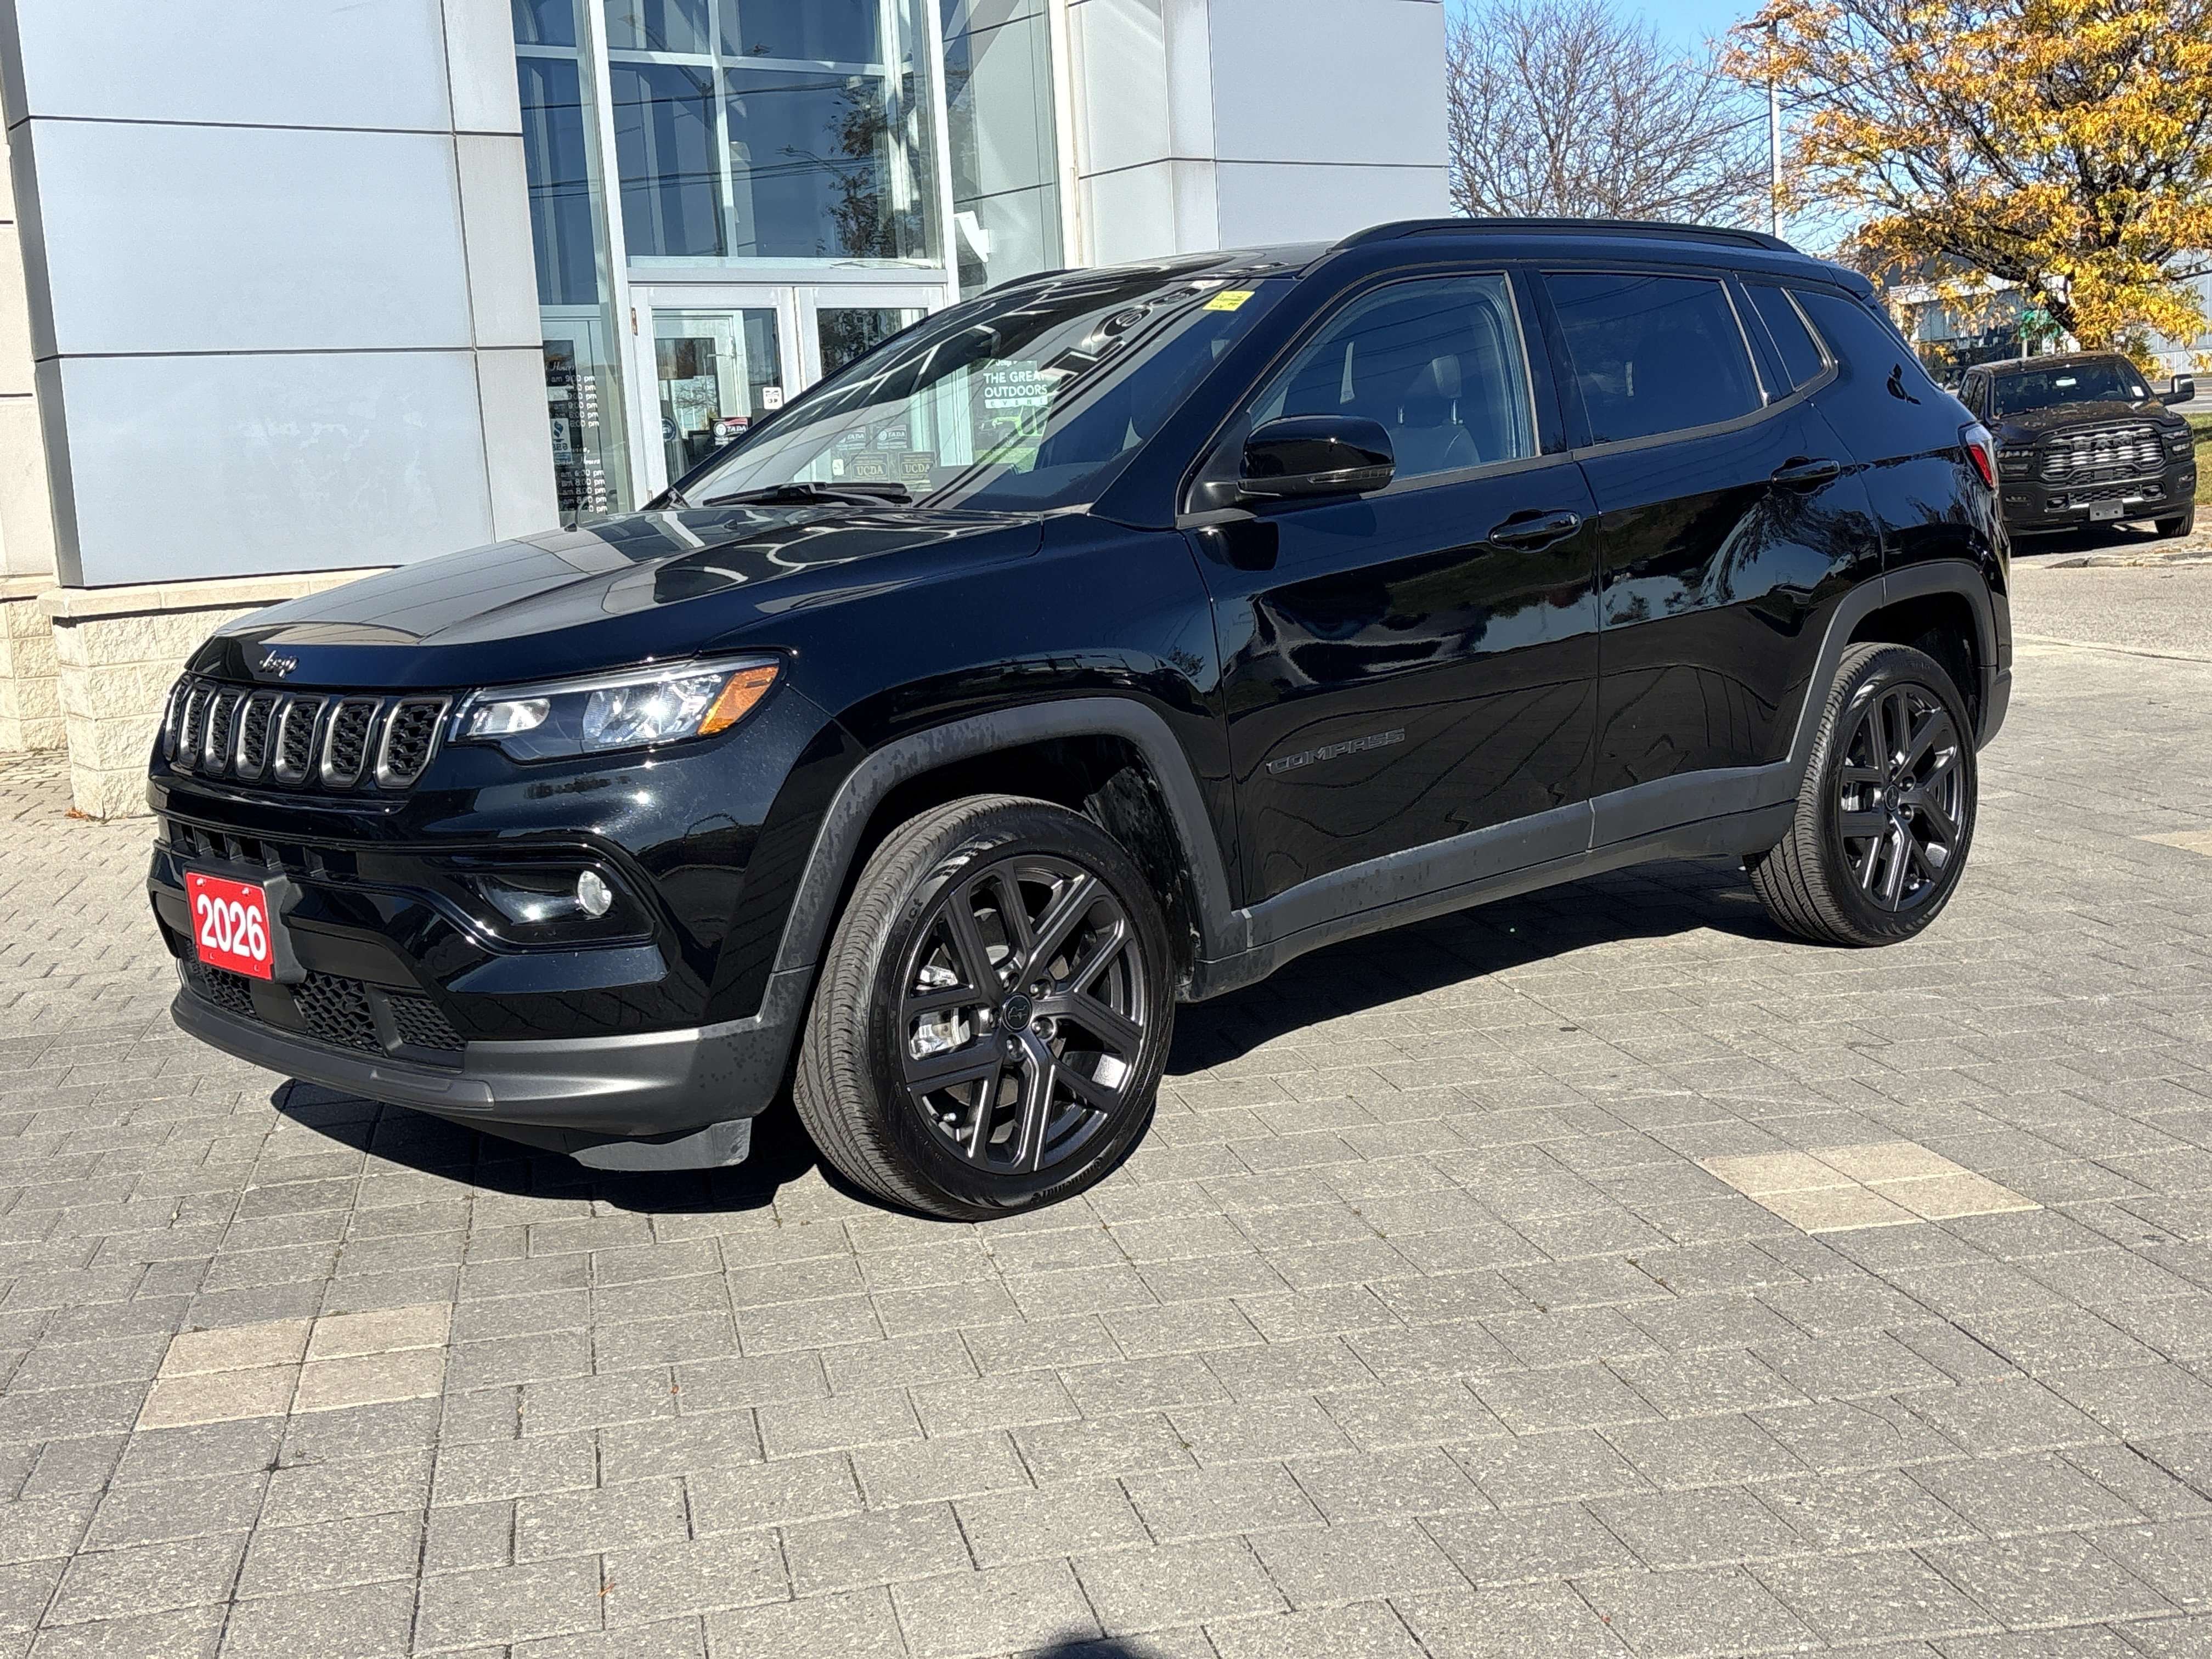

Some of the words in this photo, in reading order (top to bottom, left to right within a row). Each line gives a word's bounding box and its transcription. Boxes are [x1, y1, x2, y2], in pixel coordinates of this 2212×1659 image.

[983, 372, 1006, 384] THE
[984, 385, 1047, 398] OUTDOORS
[593, 470, 605, 478] pm
[856, 466, 884, 476] UCDA
[905, 463, 932, 475] UCDA
[594, 479, 606, 487] pm
[596, 496, 607, 504] pm
[596, 505, 608, 514] pm
[259, 650, 298, 679] Jeep
[1266, 727, 1406, 775] COMPASS
[197, 894, 267, 961] 2026
